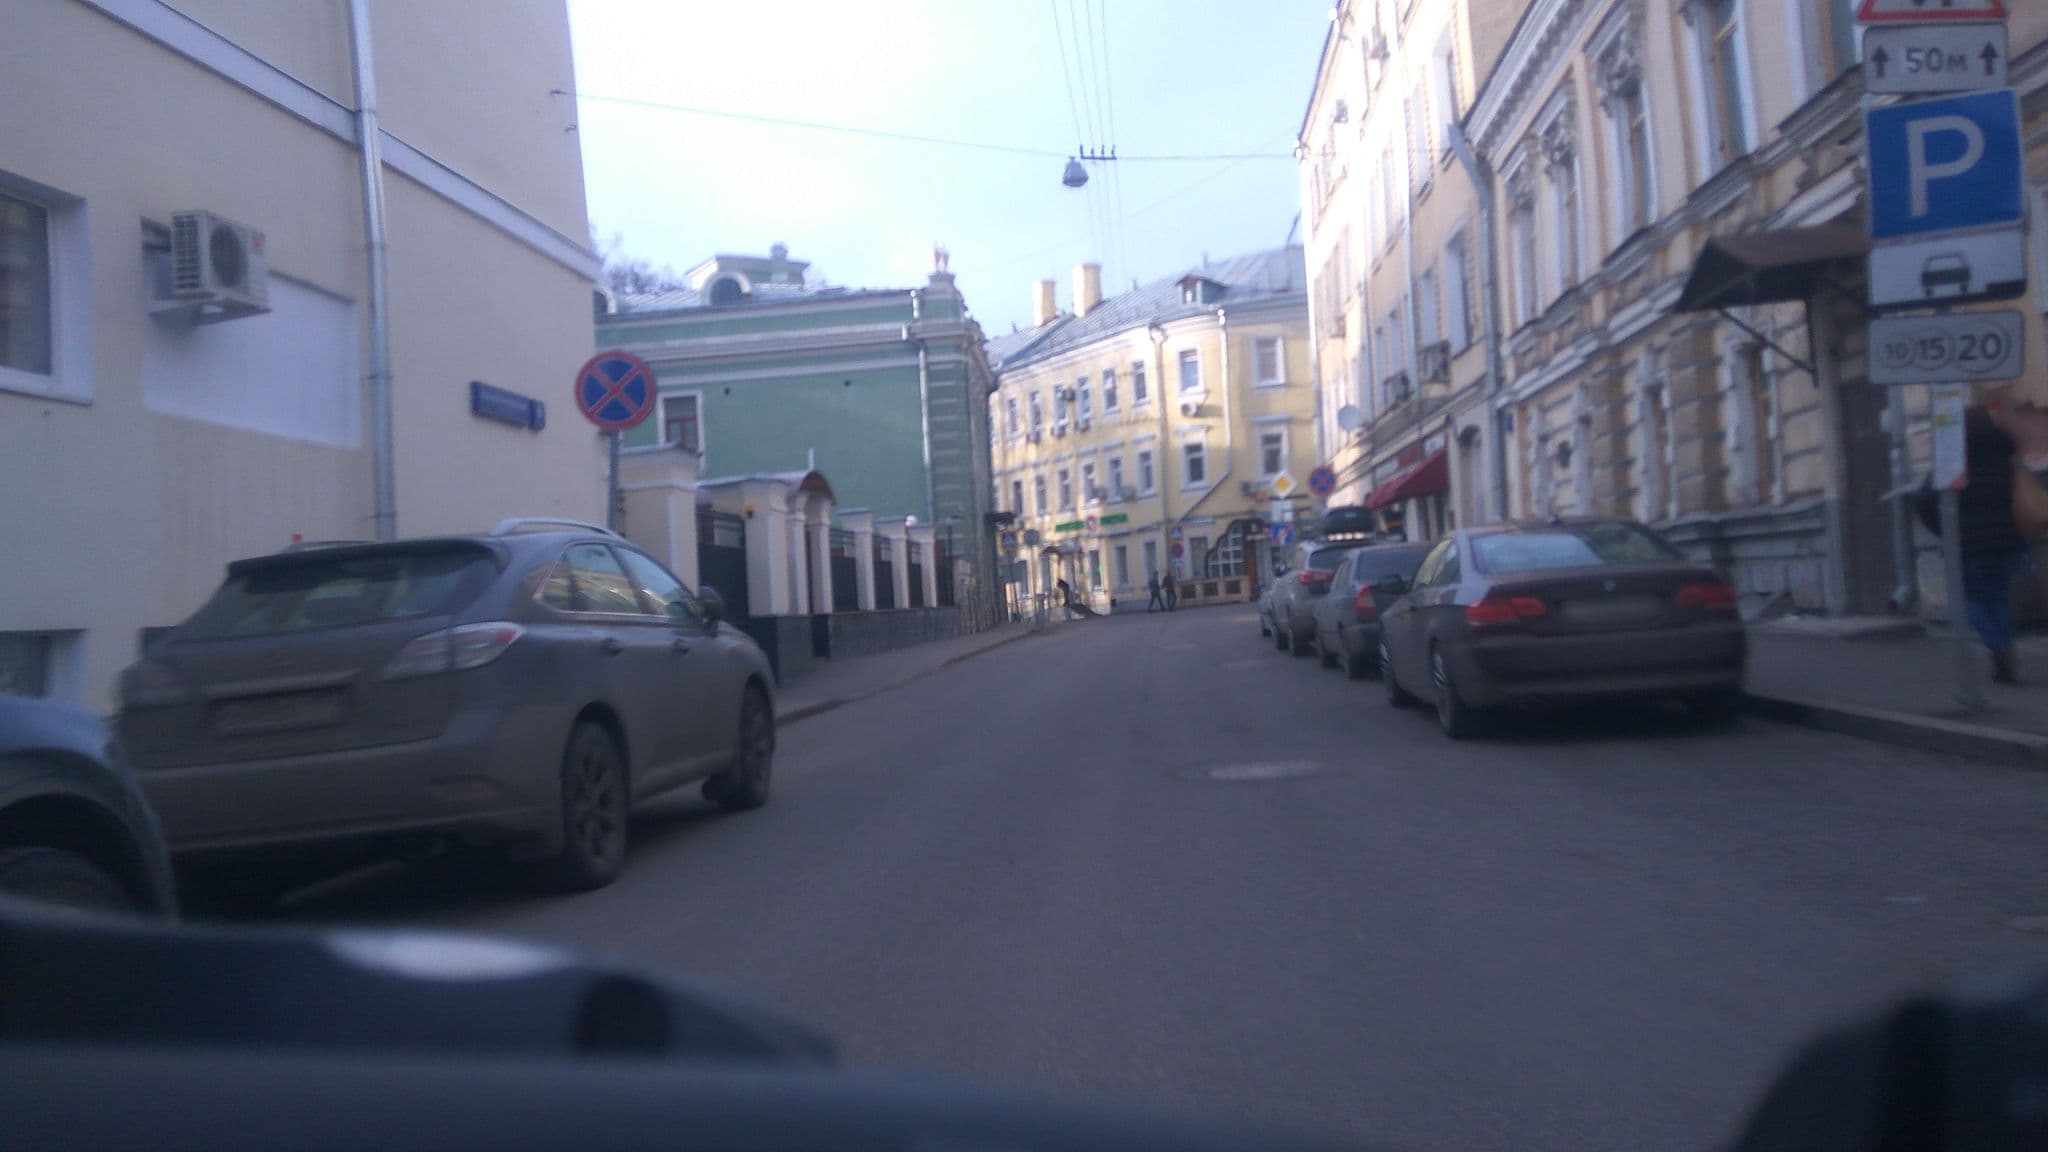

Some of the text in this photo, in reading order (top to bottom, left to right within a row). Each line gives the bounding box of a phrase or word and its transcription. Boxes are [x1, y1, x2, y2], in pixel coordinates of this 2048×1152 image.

[1906, 115, 1985, 217] P
[1919, 337, 1945, 360] 15
[1958, 332, 2000, 361] 20
